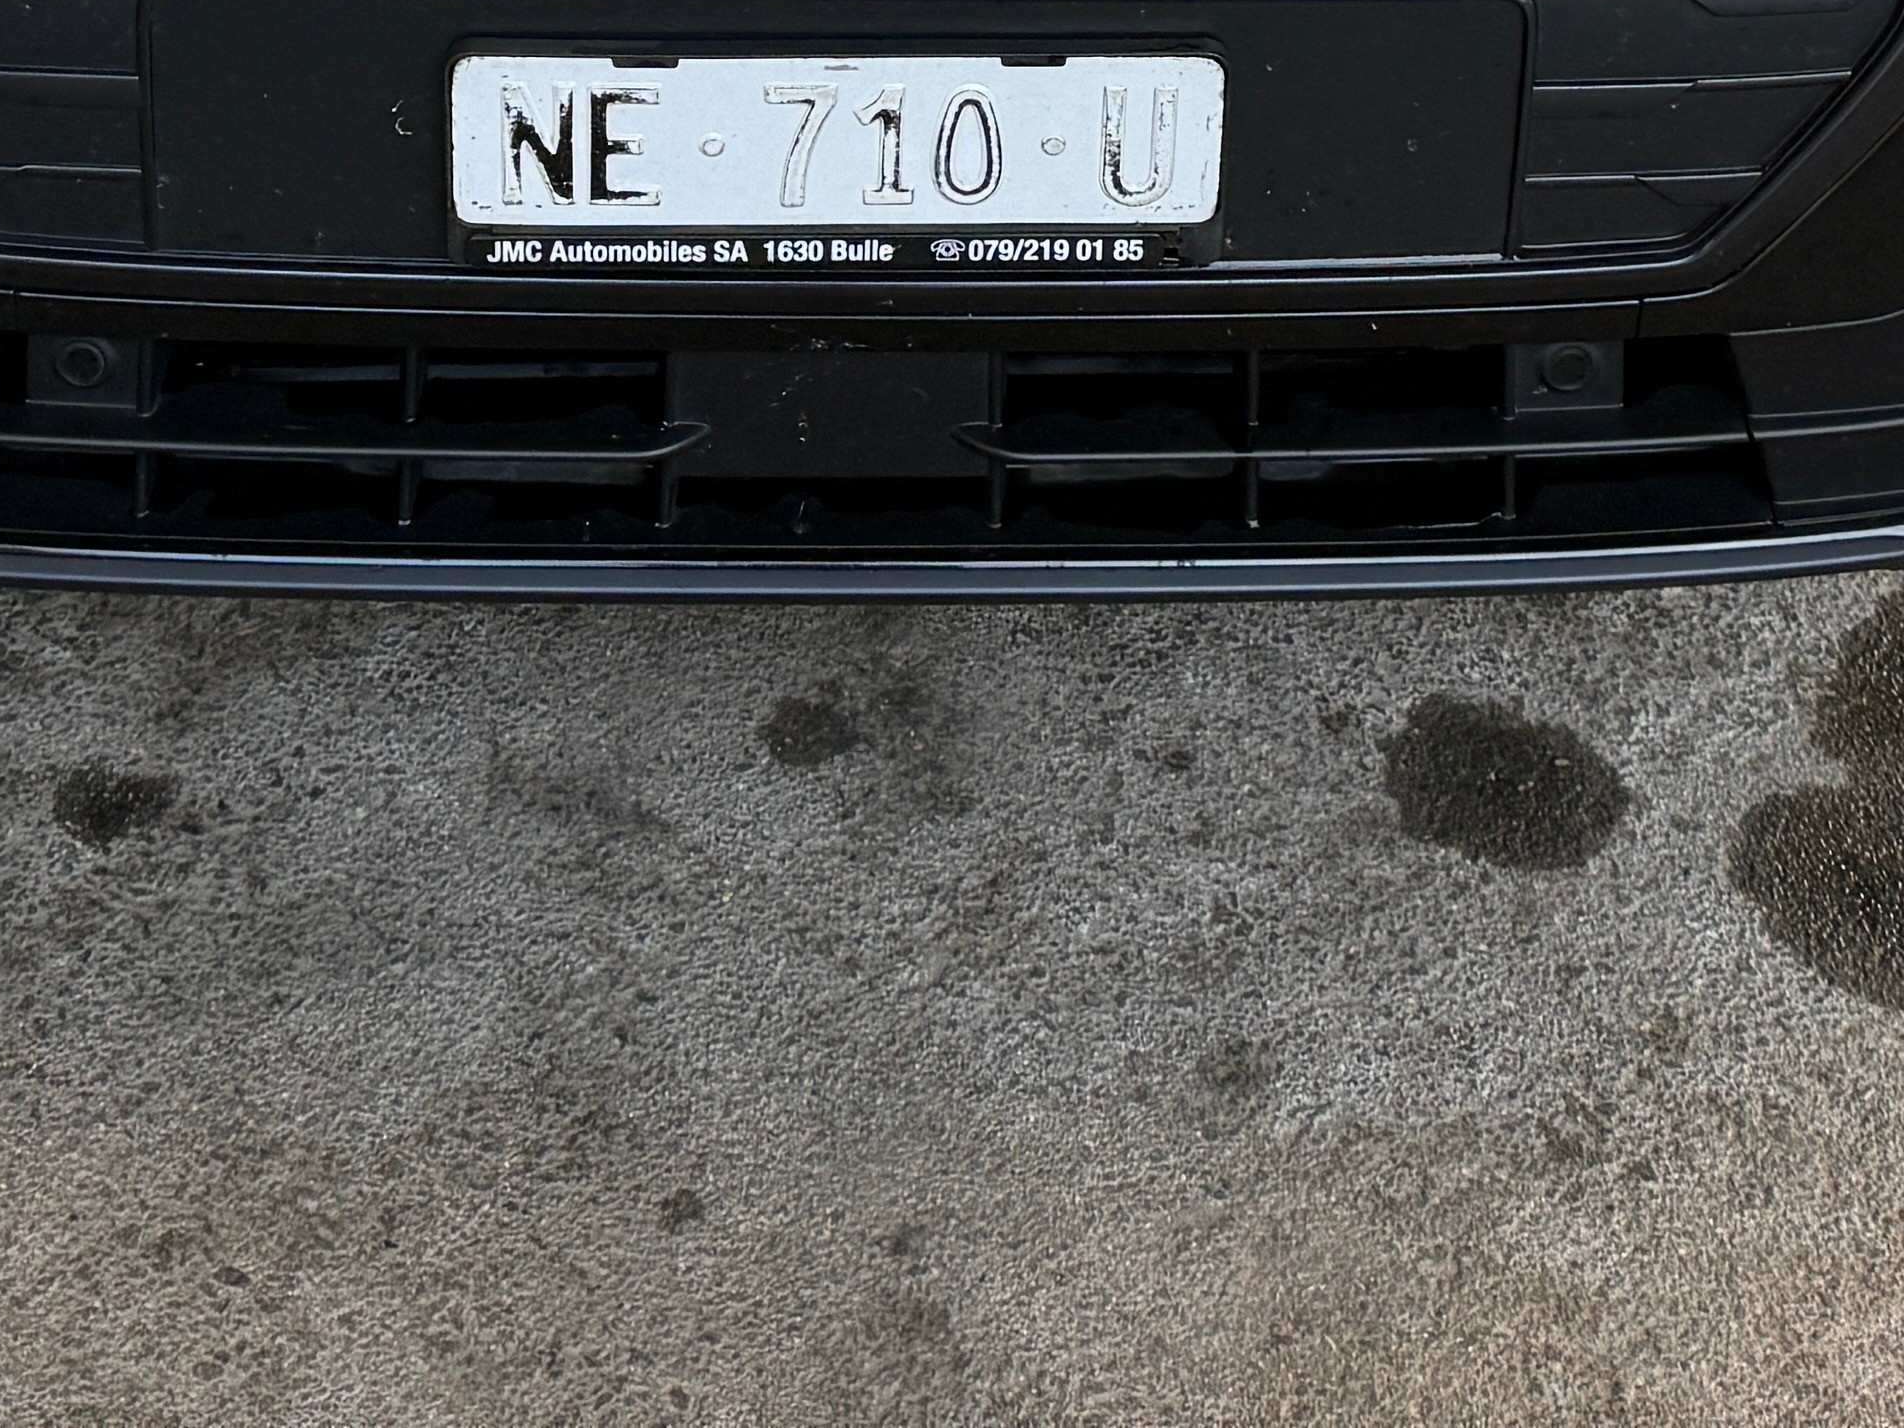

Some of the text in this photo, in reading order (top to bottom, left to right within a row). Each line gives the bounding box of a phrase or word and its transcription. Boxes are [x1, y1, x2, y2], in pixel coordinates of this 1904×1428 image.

[501, 81, 1180, 208] NE 710 U
[487, 239, 1143, 263] JMC Automobiles SA 1630 Bulle 079/219 01 85
